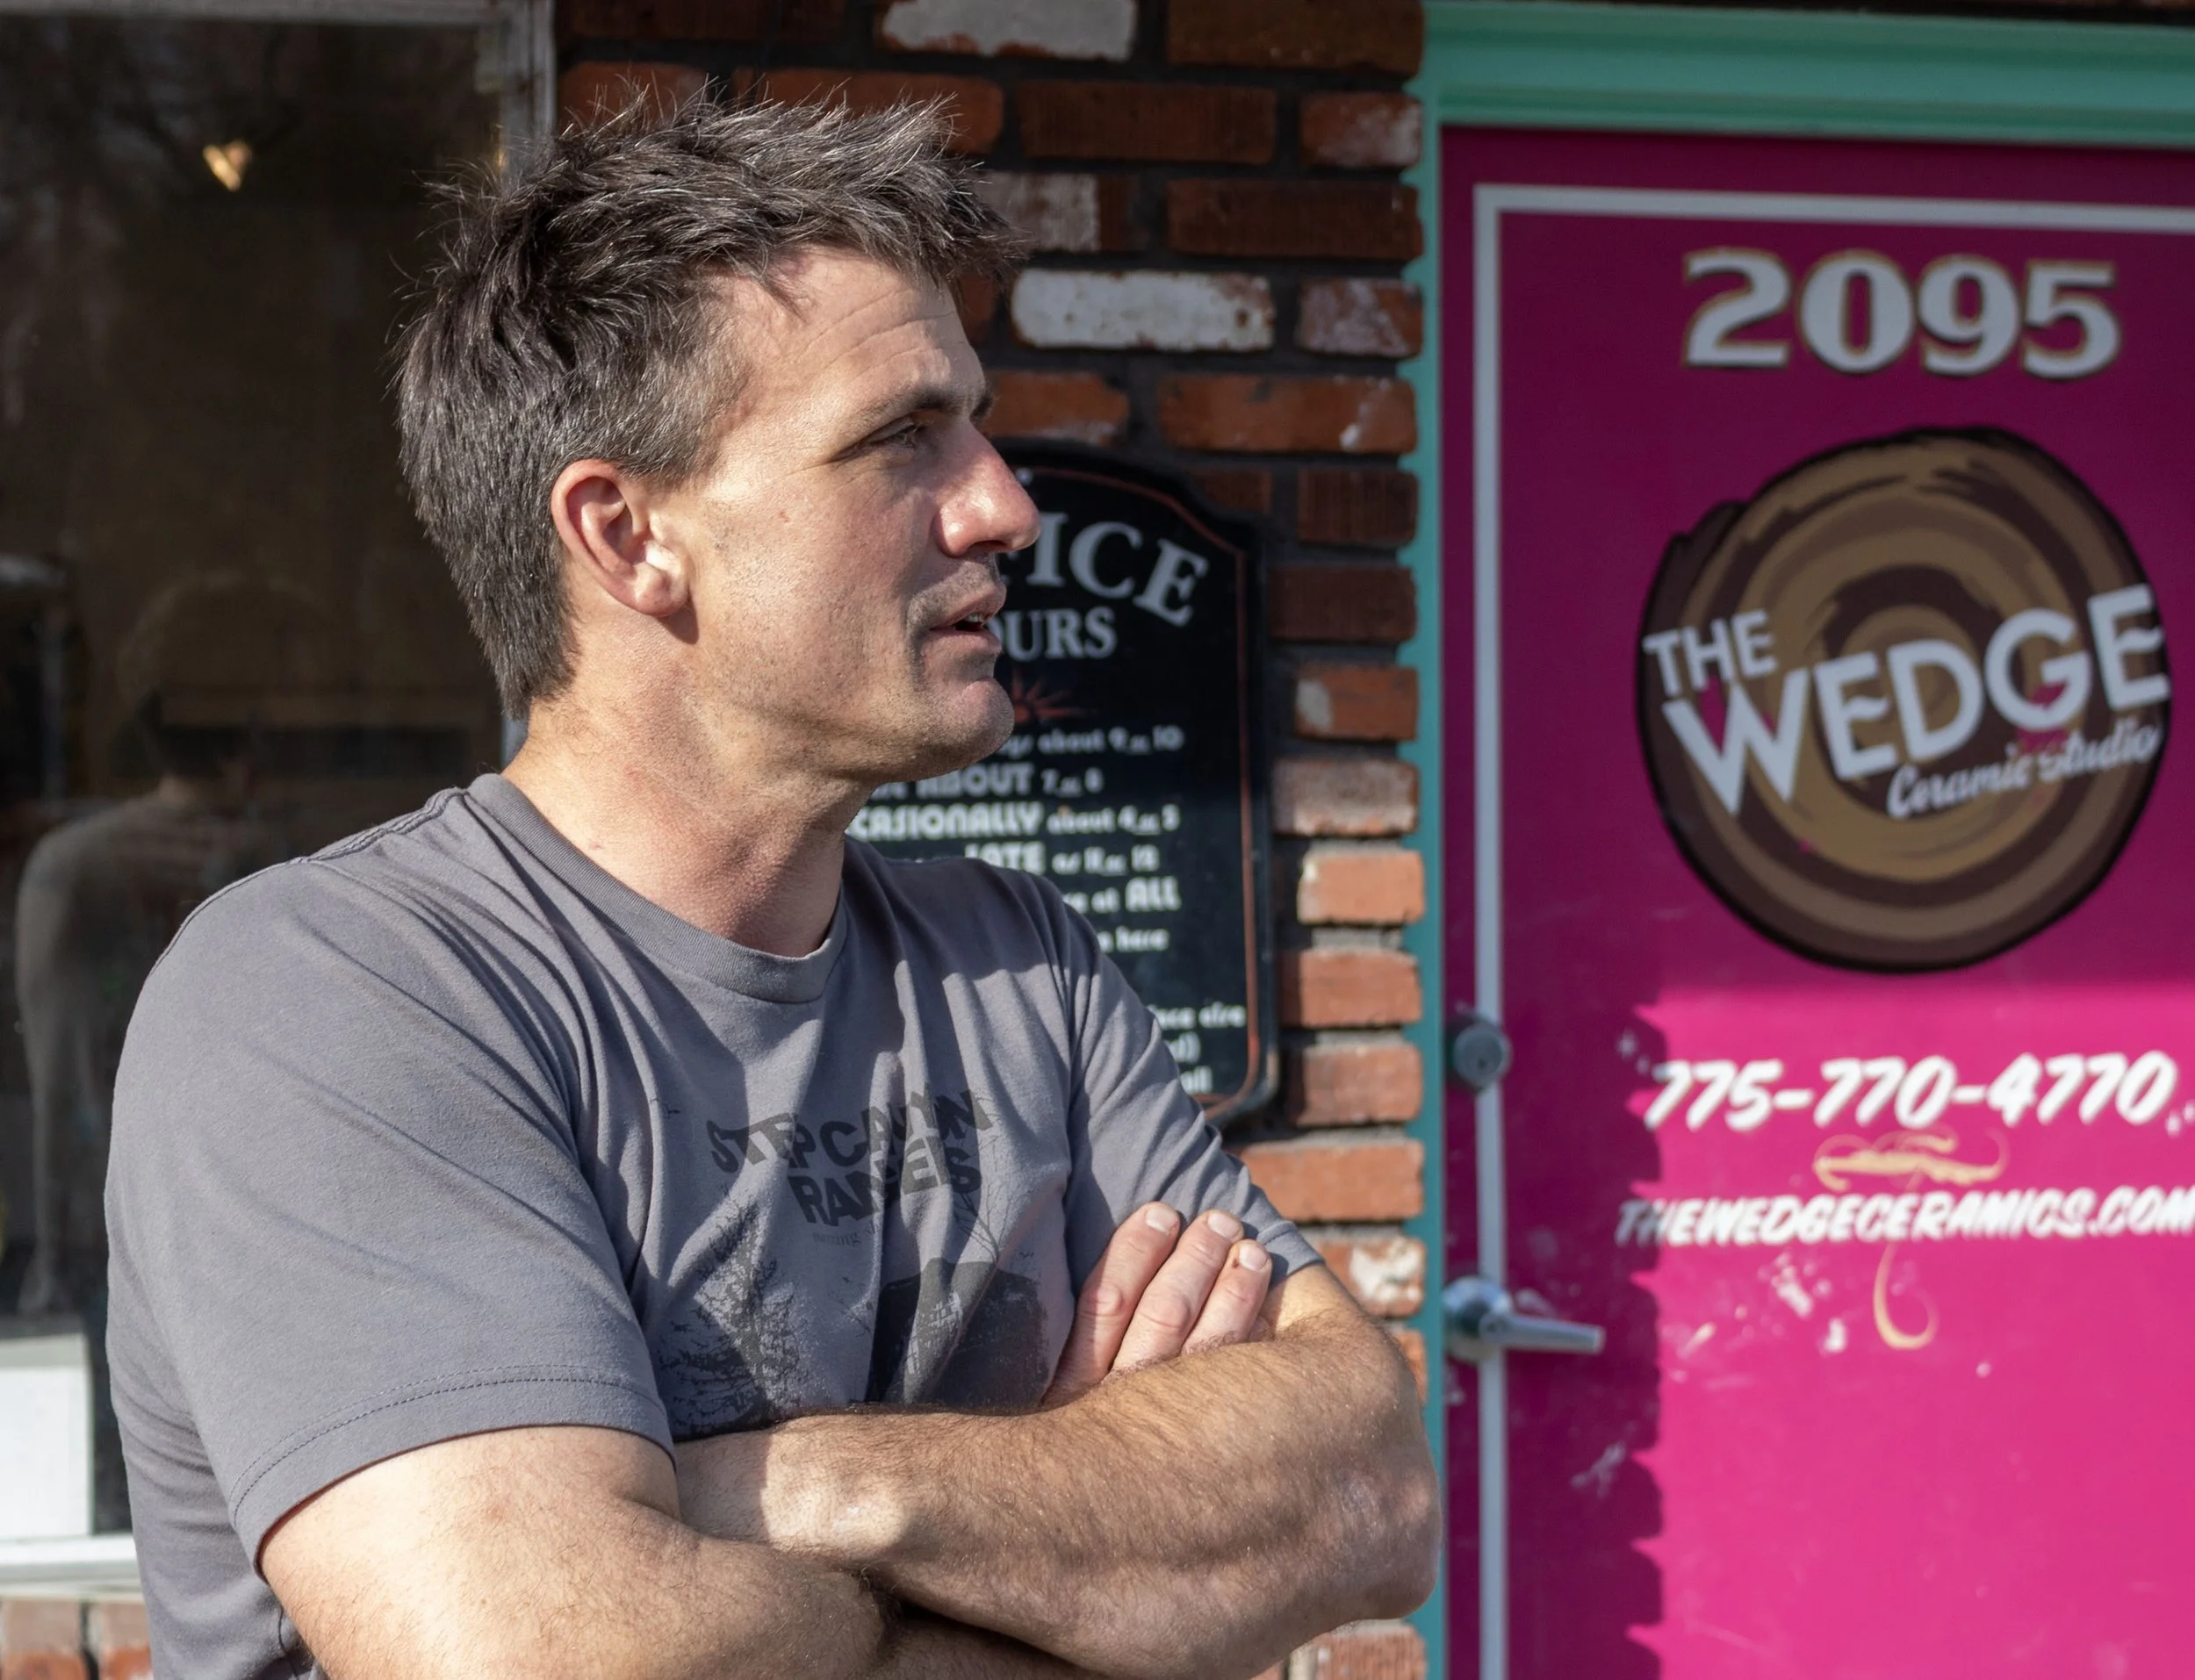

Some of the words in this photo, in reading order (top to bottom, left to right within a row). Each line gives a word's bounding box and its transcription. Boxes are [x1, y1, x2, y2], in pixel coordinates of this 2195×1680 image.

[1680, 246, 2122, 380] 2095
[1005, 510, 1210, 628] ICE
[985, 606, 1119, 662] URS
[1643, 609, 1780, 695] THE
[1662, 583, 2171, 816] WEDGE
[1037, 728, 1106, 753] about
[1886, 741, 2032, 820] Ceramic
[845, 801, 1046, 842] CASIONALLY
[1047, 805, 1116, 835] about
[1125, 876, 1183, 912] ALL
[1644, 1052, 2179, 1131] 775-770-4770
